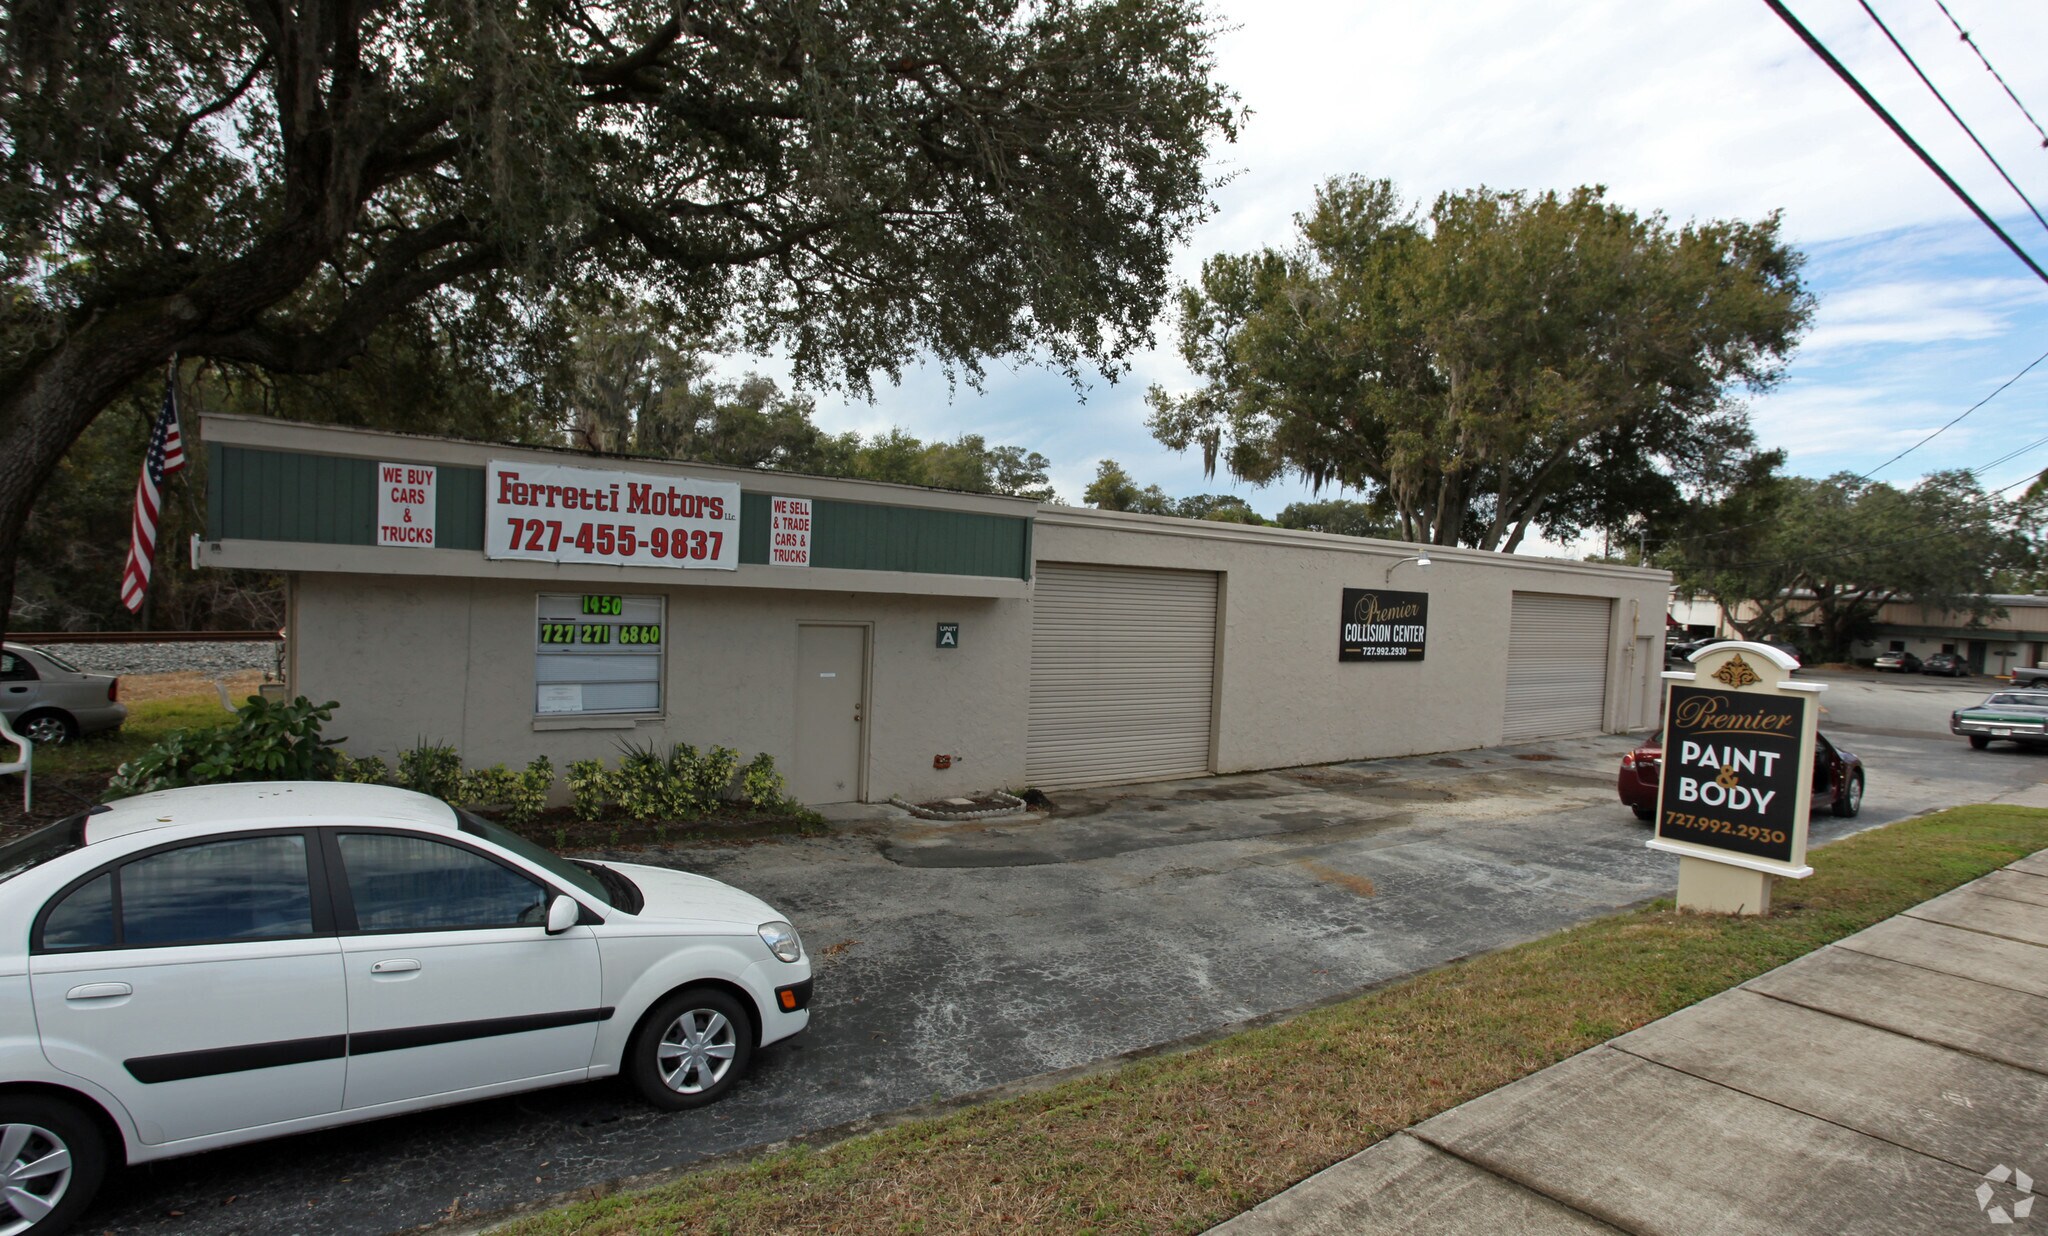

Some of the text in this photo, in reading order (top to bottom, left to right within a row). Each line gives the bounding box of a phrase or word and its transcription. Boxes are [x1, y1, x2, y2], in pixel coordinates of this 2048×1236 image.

[383, 467, 433, 485] WE BUY
[391, 487, 425, 504] CARS
[497, 471, 619, 512] Ferretti
[627, 482, 724, 520] Motors
[403, 508, 412, 523] &
[774, 500, 809, 515] WE SELL
[773, 516, 809, 531] & TRADE
[381, 526, 433, 543] TRUCKS
[507, 517, 723, 560] 727-455-9837
[775, 533, 806, 547] CARS &
[773, 549, 806, 563] TRUCKS
[583, 596, 622, 615] 1450
[1354, 593, 1420, 627] Premier
[543, 624, 659, 643] 727 271 6860
[941, 632, 955, 644] A
[1345, 623, 1425, 642] COLLISION CENTER
[1363, 647, 1407, 655] 727.992.2930
[1675, 696, 1793, 729] Premier
[1680, 741, 1781, 777] PAINT
[1715, 764, 1739, 790] &
[1679, 777, 1776, 815] BODY
[1666, 811, 1786, 844] 727.992.2930
